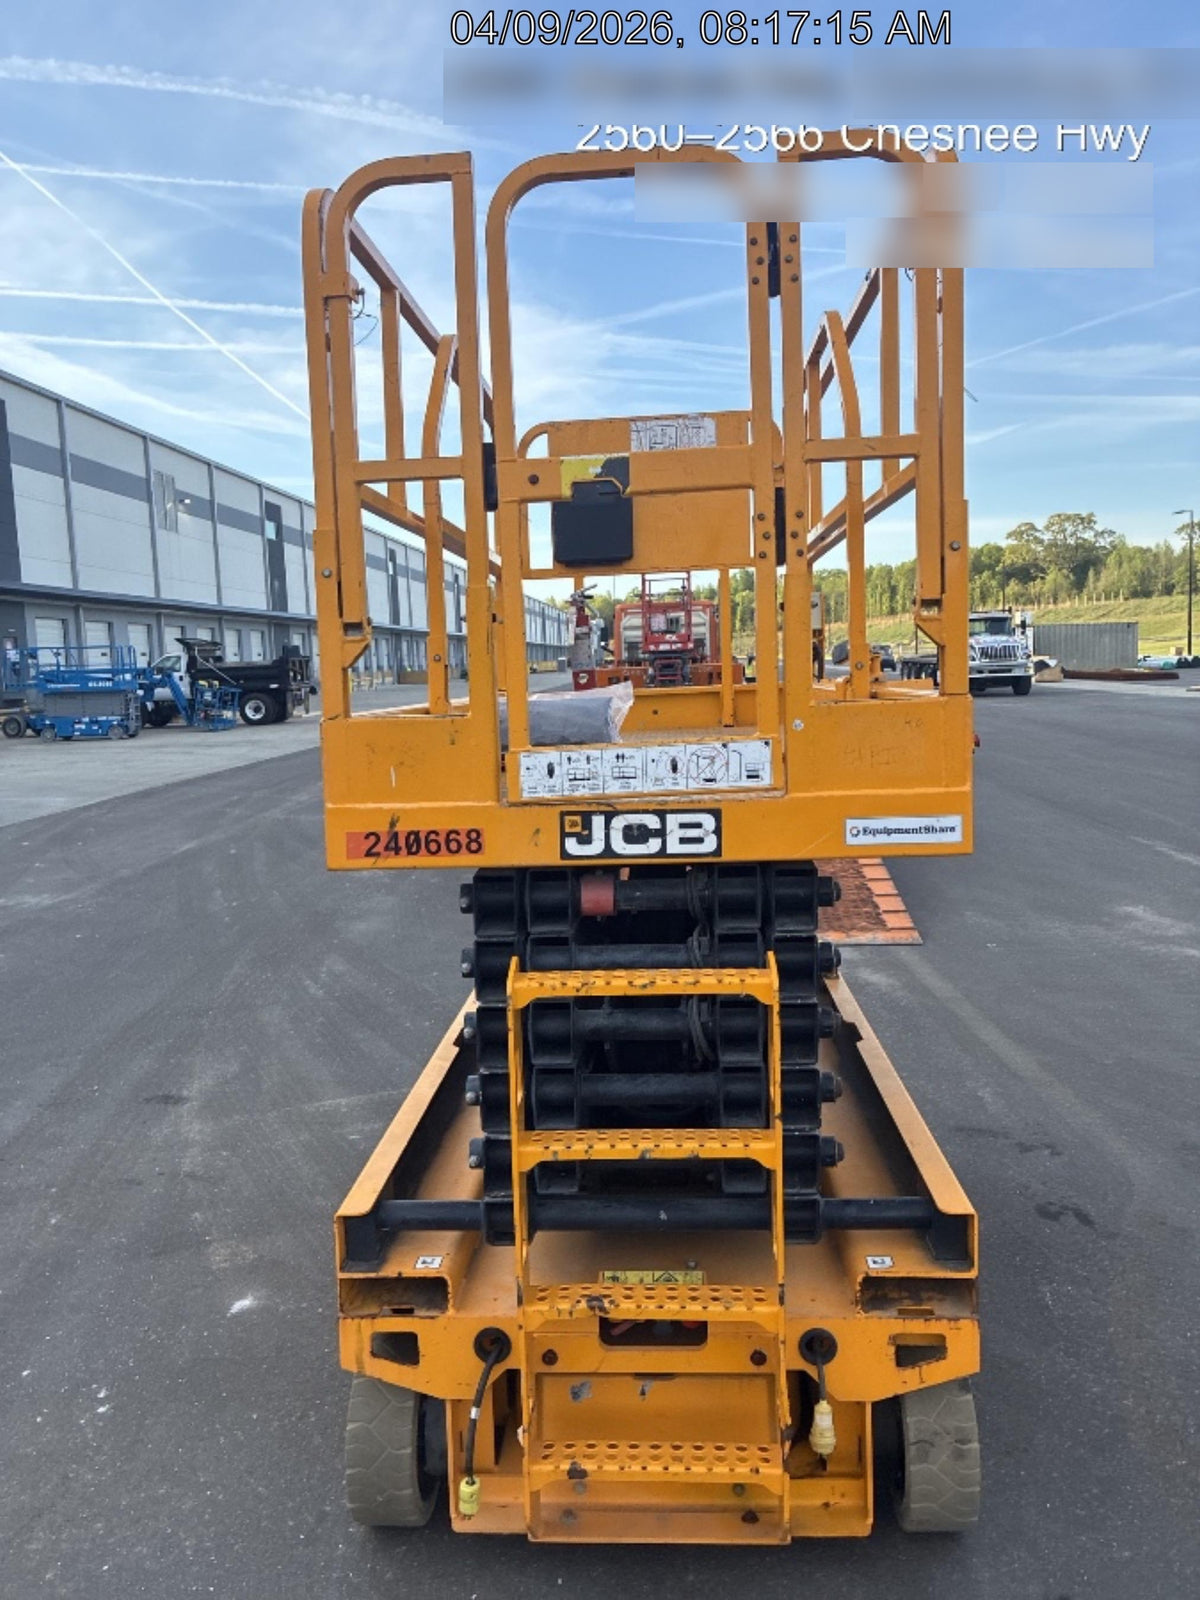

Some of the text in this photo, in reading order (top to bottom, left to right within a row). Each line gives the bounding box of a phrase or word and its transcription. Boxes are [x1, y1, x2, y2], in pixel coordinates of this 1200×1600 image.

[363, 828, 482, 858] 240668
[564, 812, 718, 856] JCB
[861, 825, 956, 837] EquipmentShare
